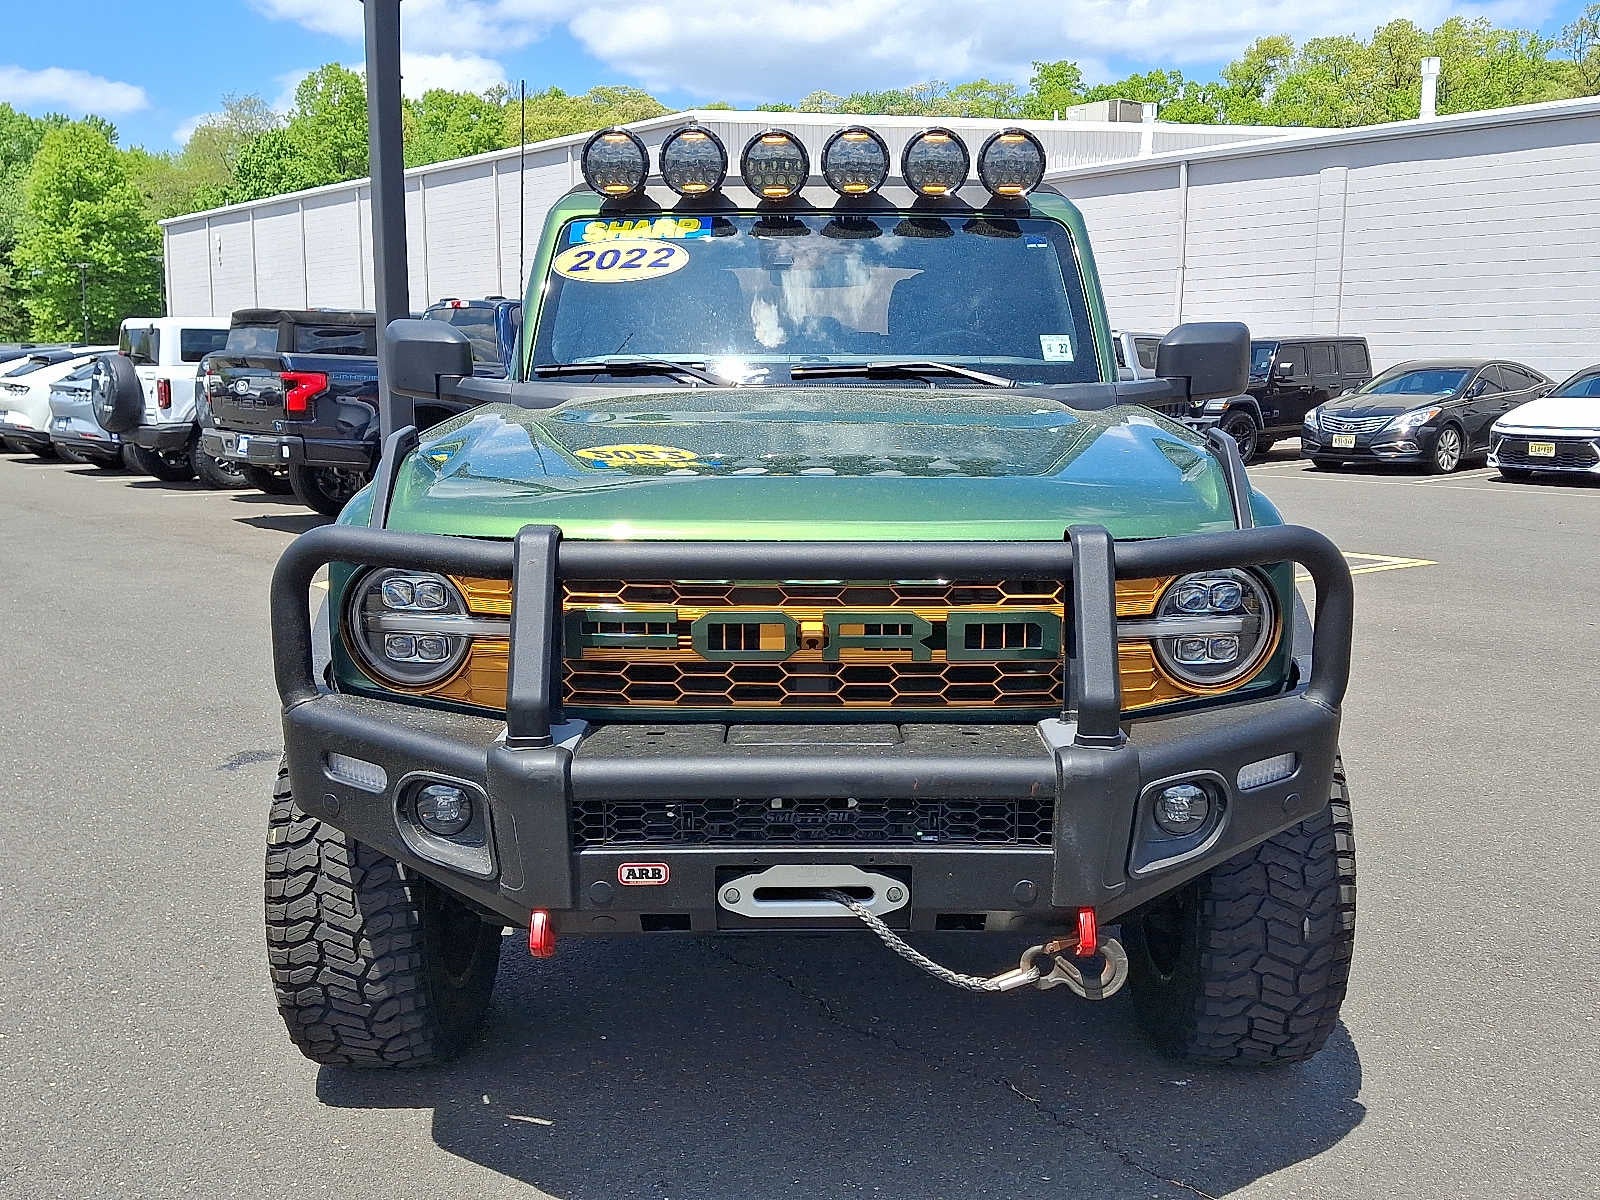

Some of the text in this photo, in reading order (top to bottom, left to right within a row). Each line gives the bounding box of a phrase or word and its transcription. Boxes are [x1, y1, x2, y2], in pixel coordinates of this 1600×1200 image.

[582, 218, 702, 241] SHARP
[567, 247, 676, 272] 2022
[562, 607, 1061, 661] FORD
[625, 867, 663, 880] ARB
